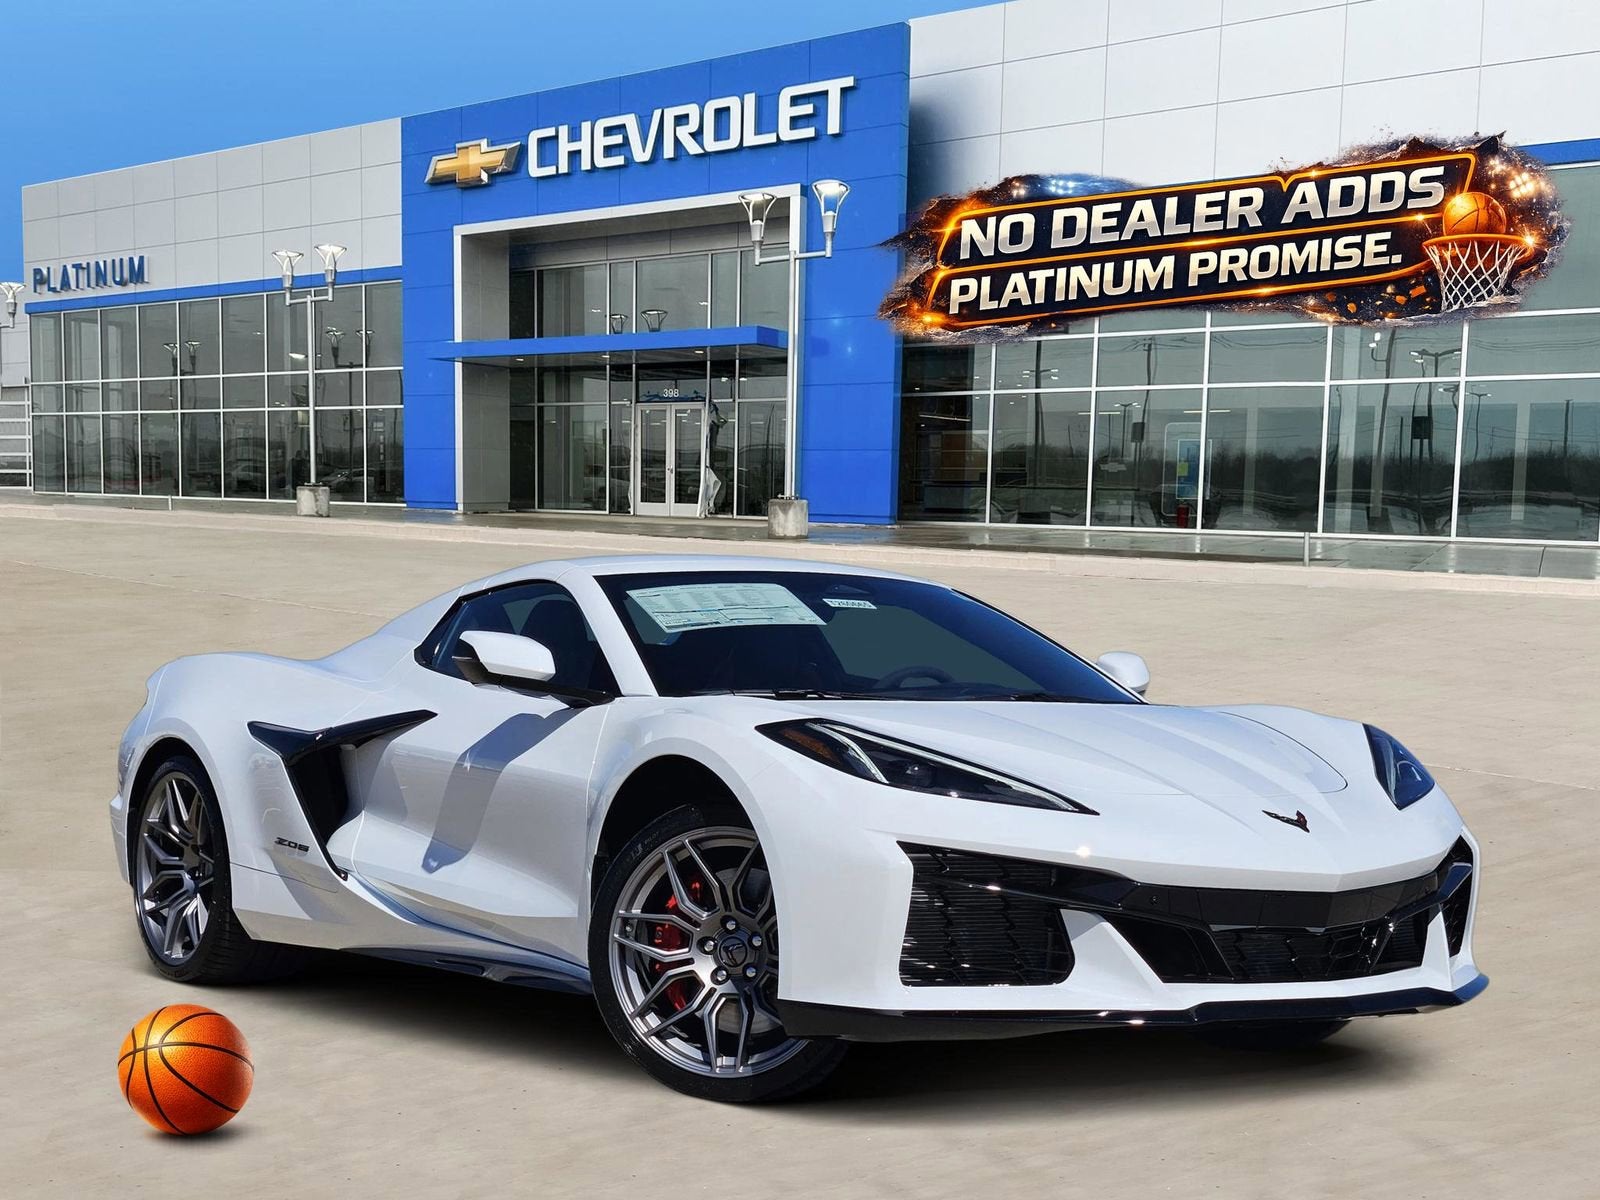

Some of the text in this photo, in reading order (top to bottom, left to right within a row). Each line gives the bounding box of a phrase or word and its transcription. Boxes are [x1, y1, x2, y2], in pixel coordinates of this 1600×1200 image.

[528, 76, 855, 178] CHEVROLET
[33, 255, 146, 292] PLATINUM
[663, 388, 679, 398] 398
